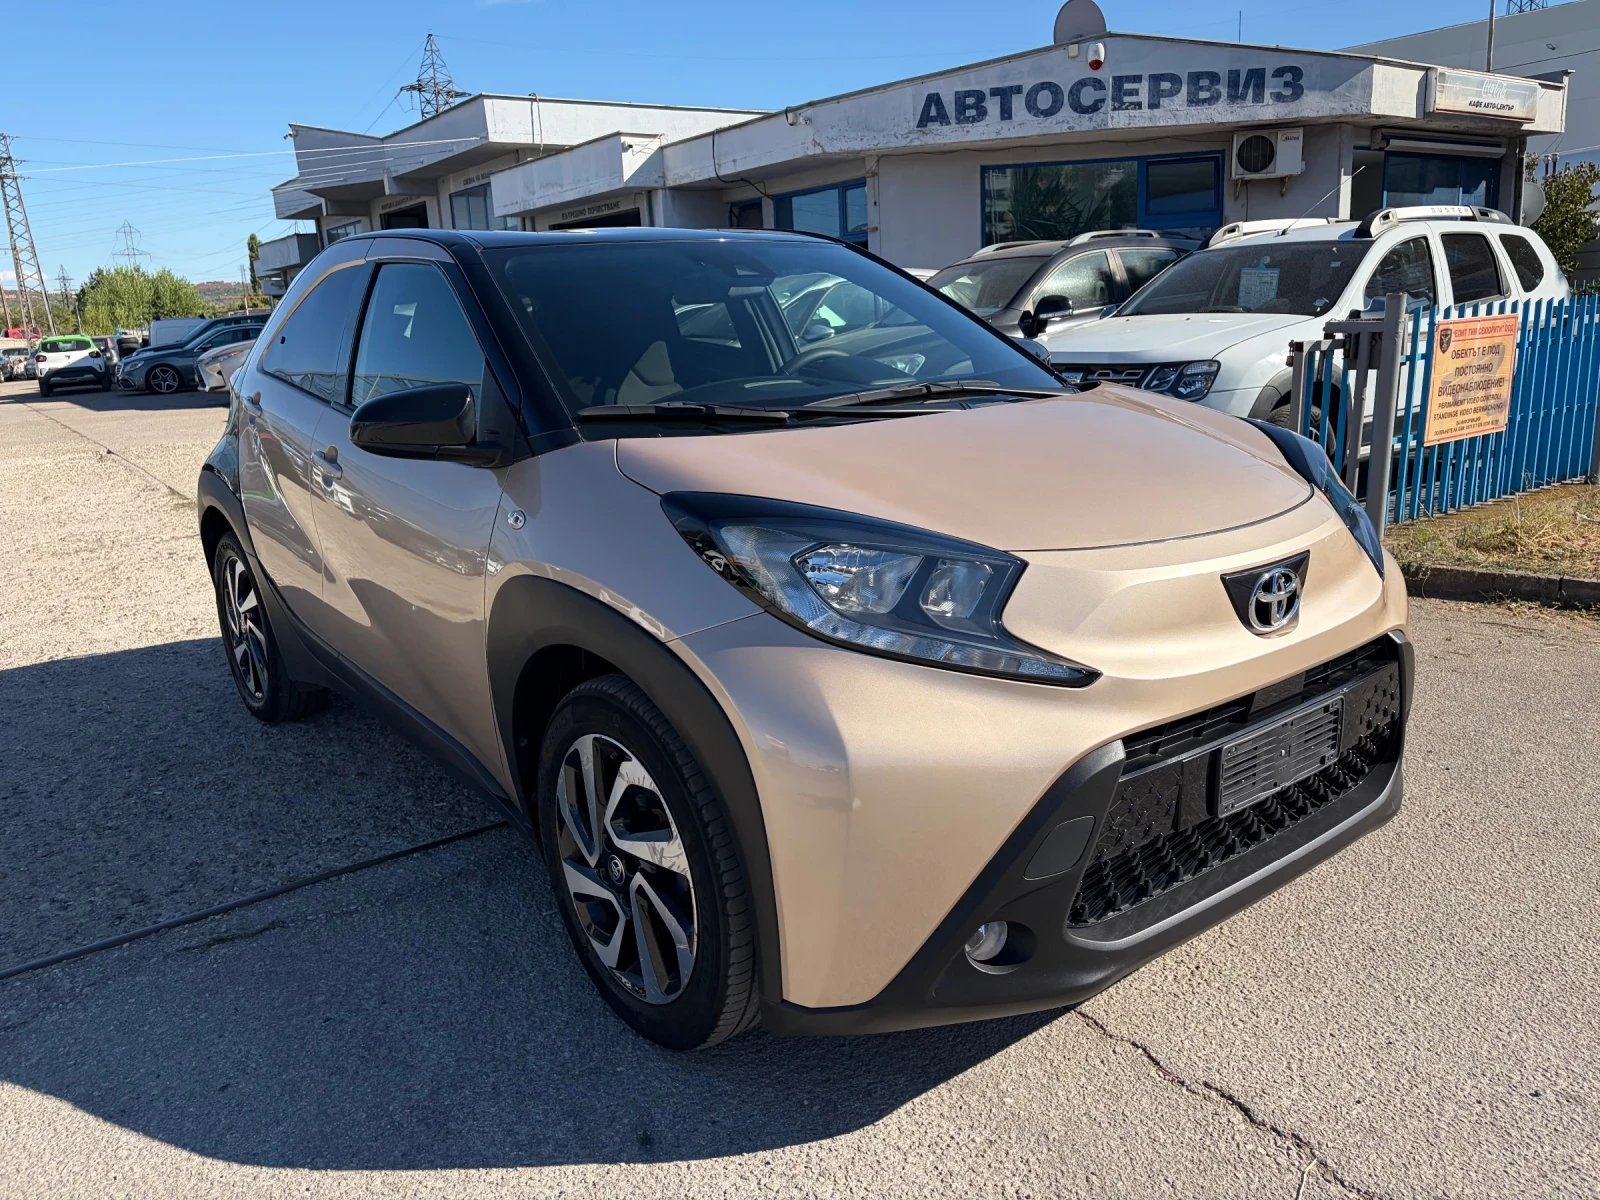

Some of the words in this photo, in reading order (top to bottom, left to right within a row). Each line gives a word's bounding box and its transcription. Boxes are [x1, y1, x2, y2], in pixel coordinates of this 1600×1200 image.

[916, 66, 1304, 128] АВТОСЕРВИЗ
[1468, 100, 1482, 108] КАФЕ
[1483, 101, 1514, 111] АВТО-ЦЕНТЪР
[587, 201, 620, 215] ПОЧИСТВАНЕ
[1451, 346, 1481, 360] ОБЕКТЪТ
[1482, 346, 1486, 356] Е
[1487, 344, 1500, 356] ПОД
[1454, 363, 1493, 377] ПОСТОЯННО
[1438, 378, 1504, 397] ВИДЕОНАБЛЮДЕНИЕ!
[1438, 398, 1466, 410] PERMANENT
[1466, 396, 1479, 405] VIDEO
[1459, 407, 1473, 417] VIDEO
